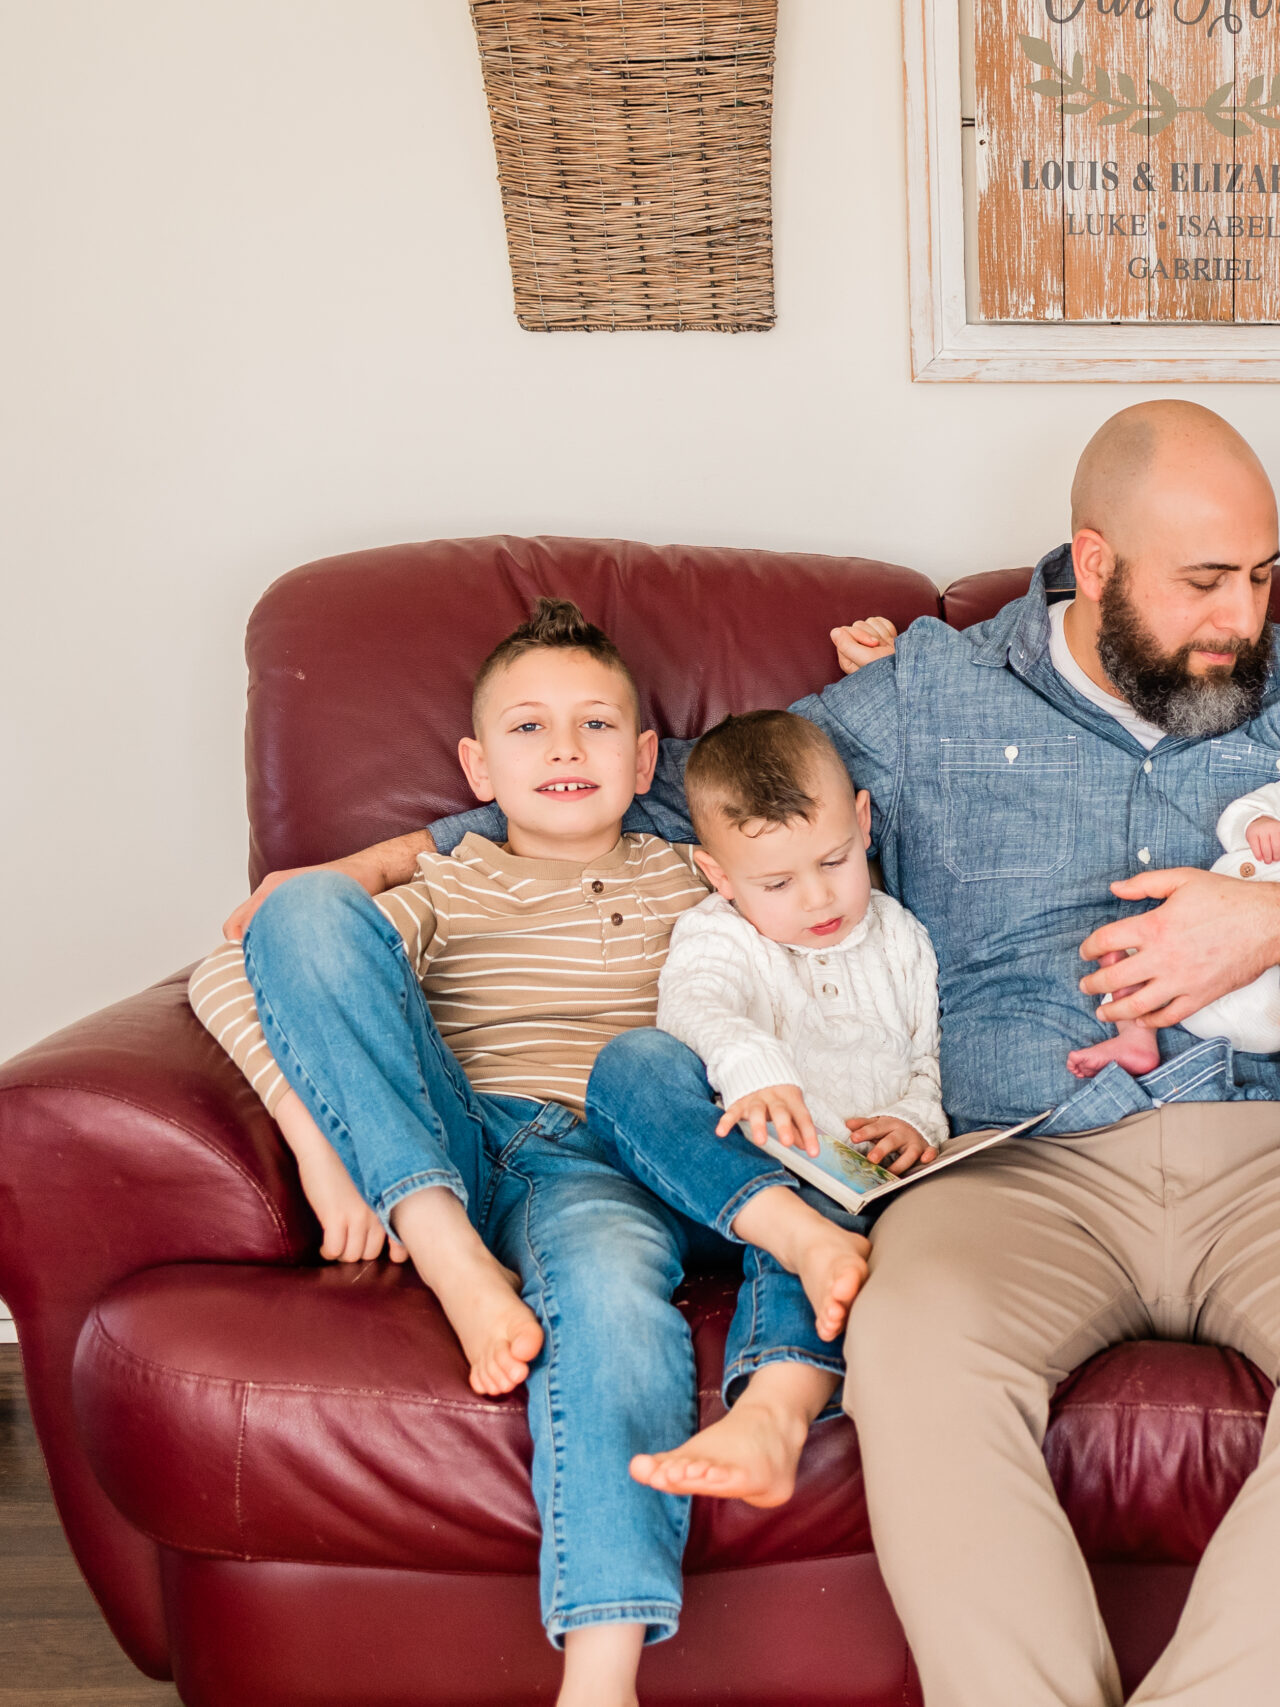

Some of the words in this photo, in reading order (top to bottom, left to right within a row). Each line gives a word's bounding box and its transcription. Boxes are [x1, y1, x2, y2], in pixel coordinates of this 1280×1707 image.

[1021, 160, 1119, 192] LOUIS
[1132, 162, 1157, 193] &
[1066, 213, 1147, 236] LUKE
[1127, 256, 1262, 282] GABRIEL
